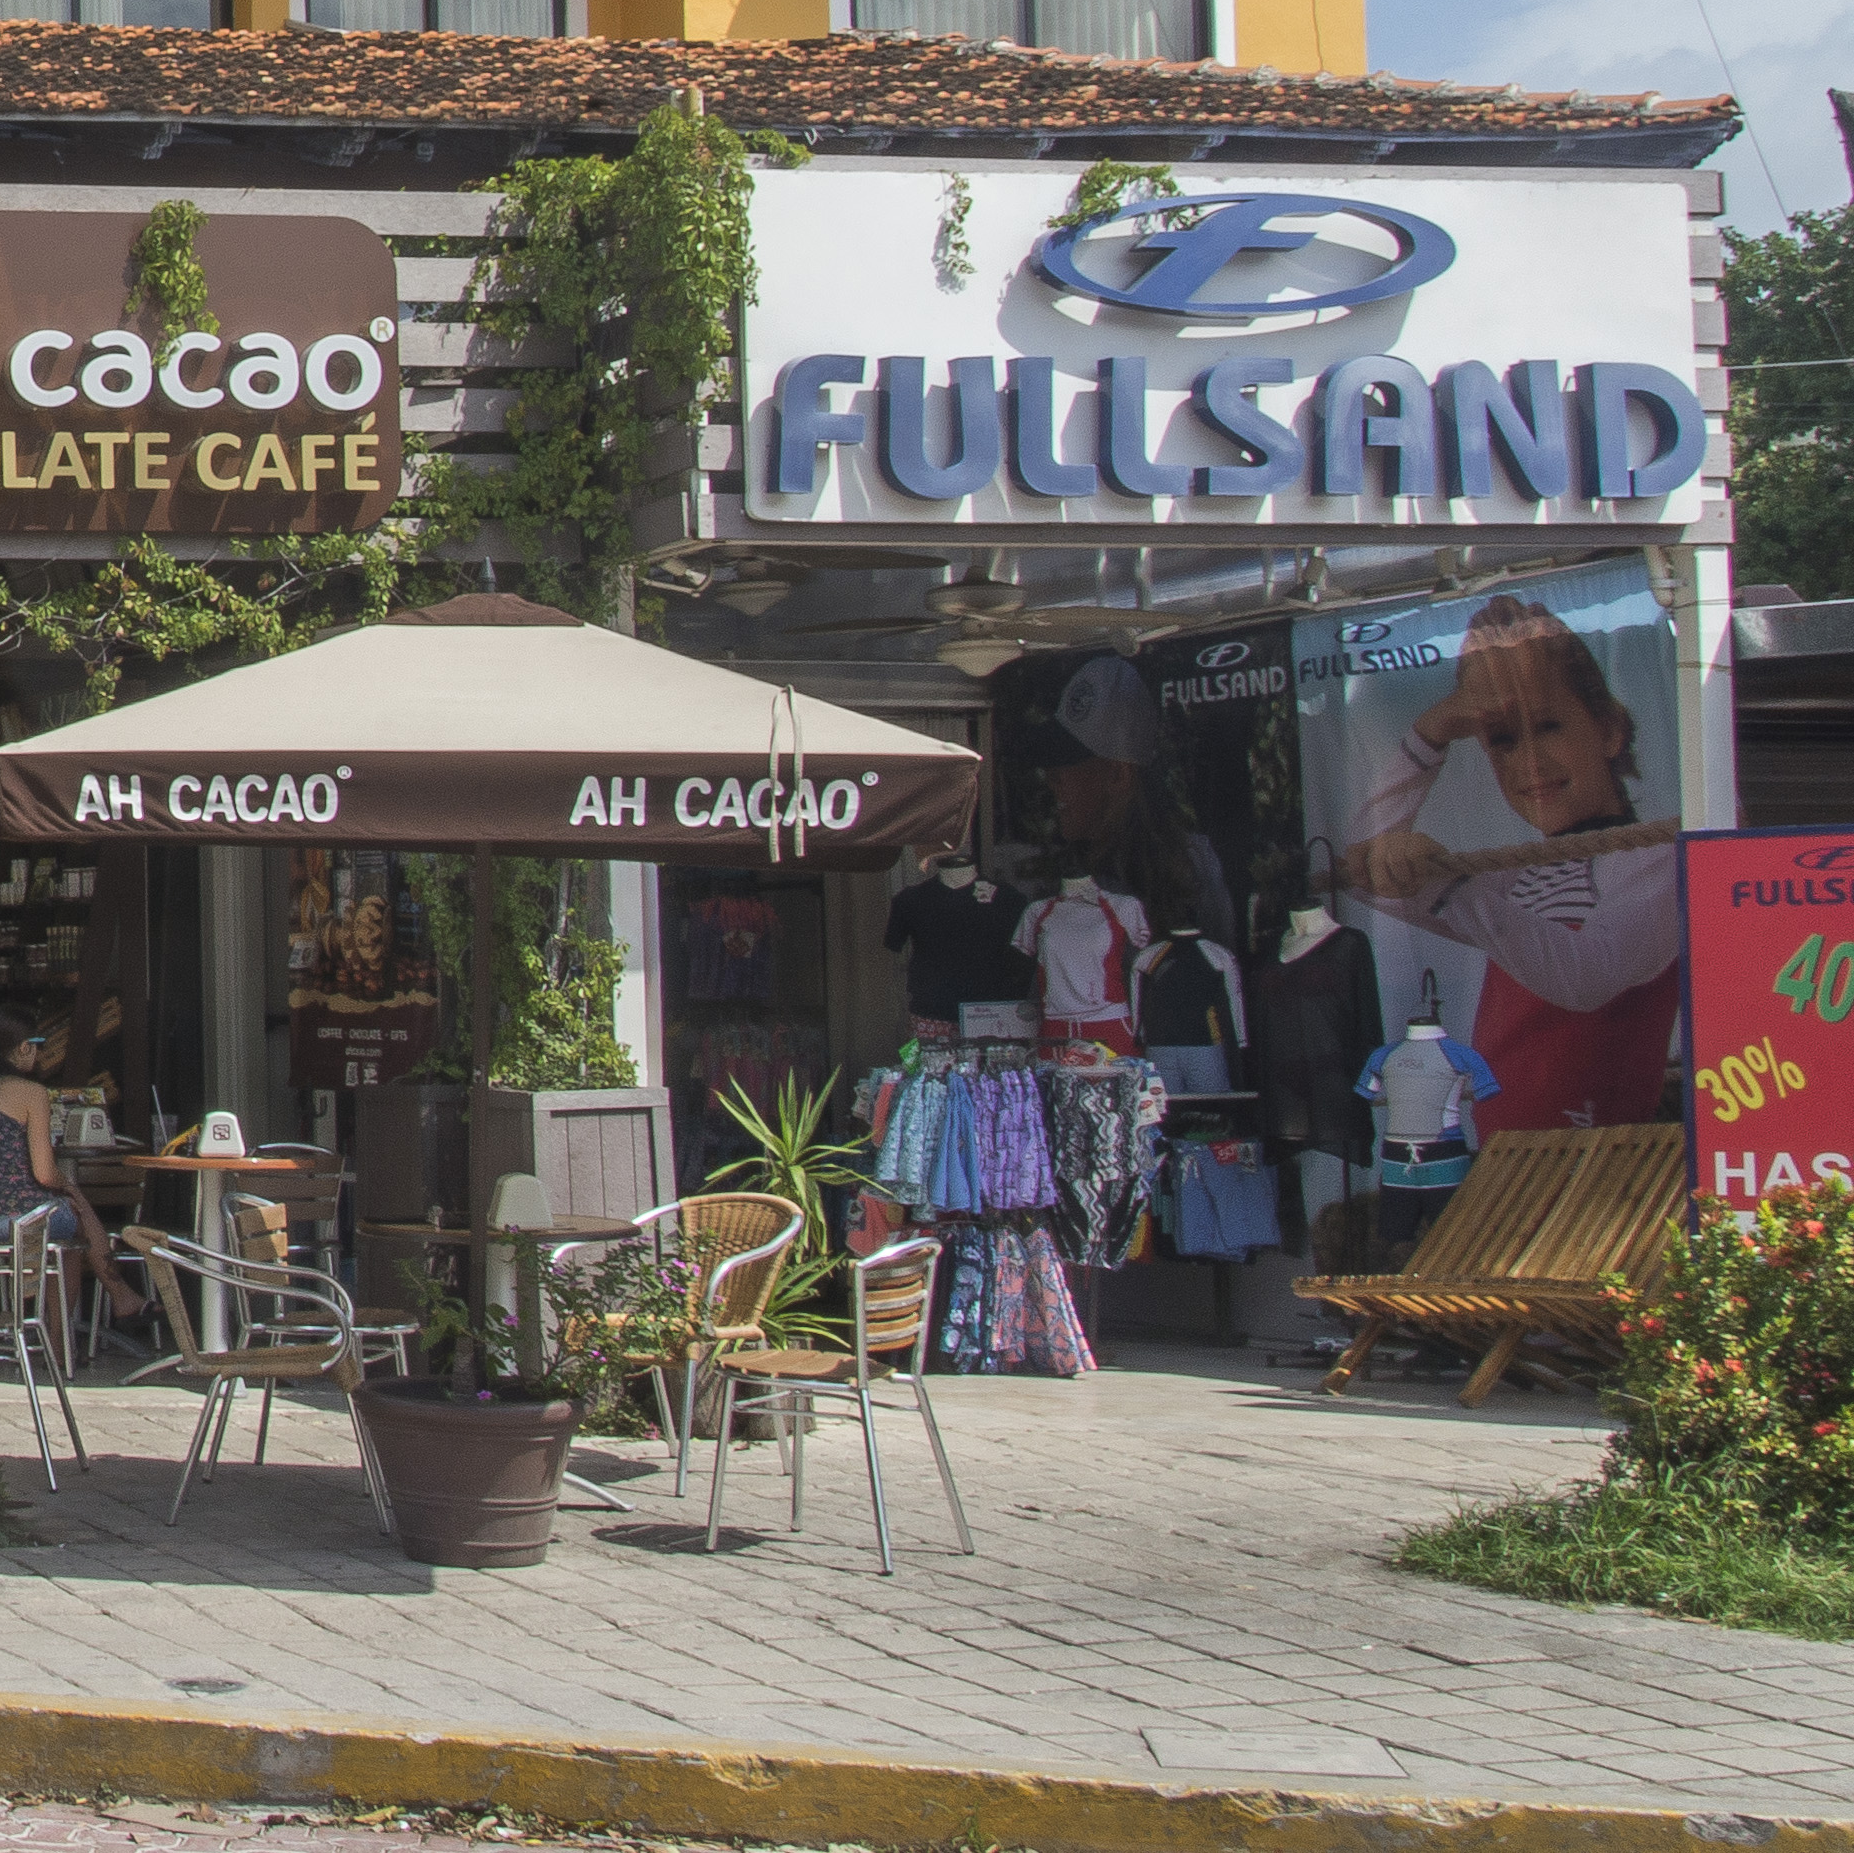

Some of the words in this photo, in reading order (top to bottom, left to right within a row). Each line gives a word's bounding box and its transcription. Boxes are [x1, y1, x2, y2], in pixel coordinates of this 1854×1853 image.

[195, 411, 381, 492] CAFÉ
[766, 352, 1706, 503] FULLSAND
[1160, 664, 1289, 709] FULLSAND
[1298, 642, 1442, 685] FULLSAND
[75, 774, 144, 822] AH
[569, 775, 647, 826] AH
[1731, 877, 1854, 908] FULLS
[1695, 1035, 1807, 1123] 30%
